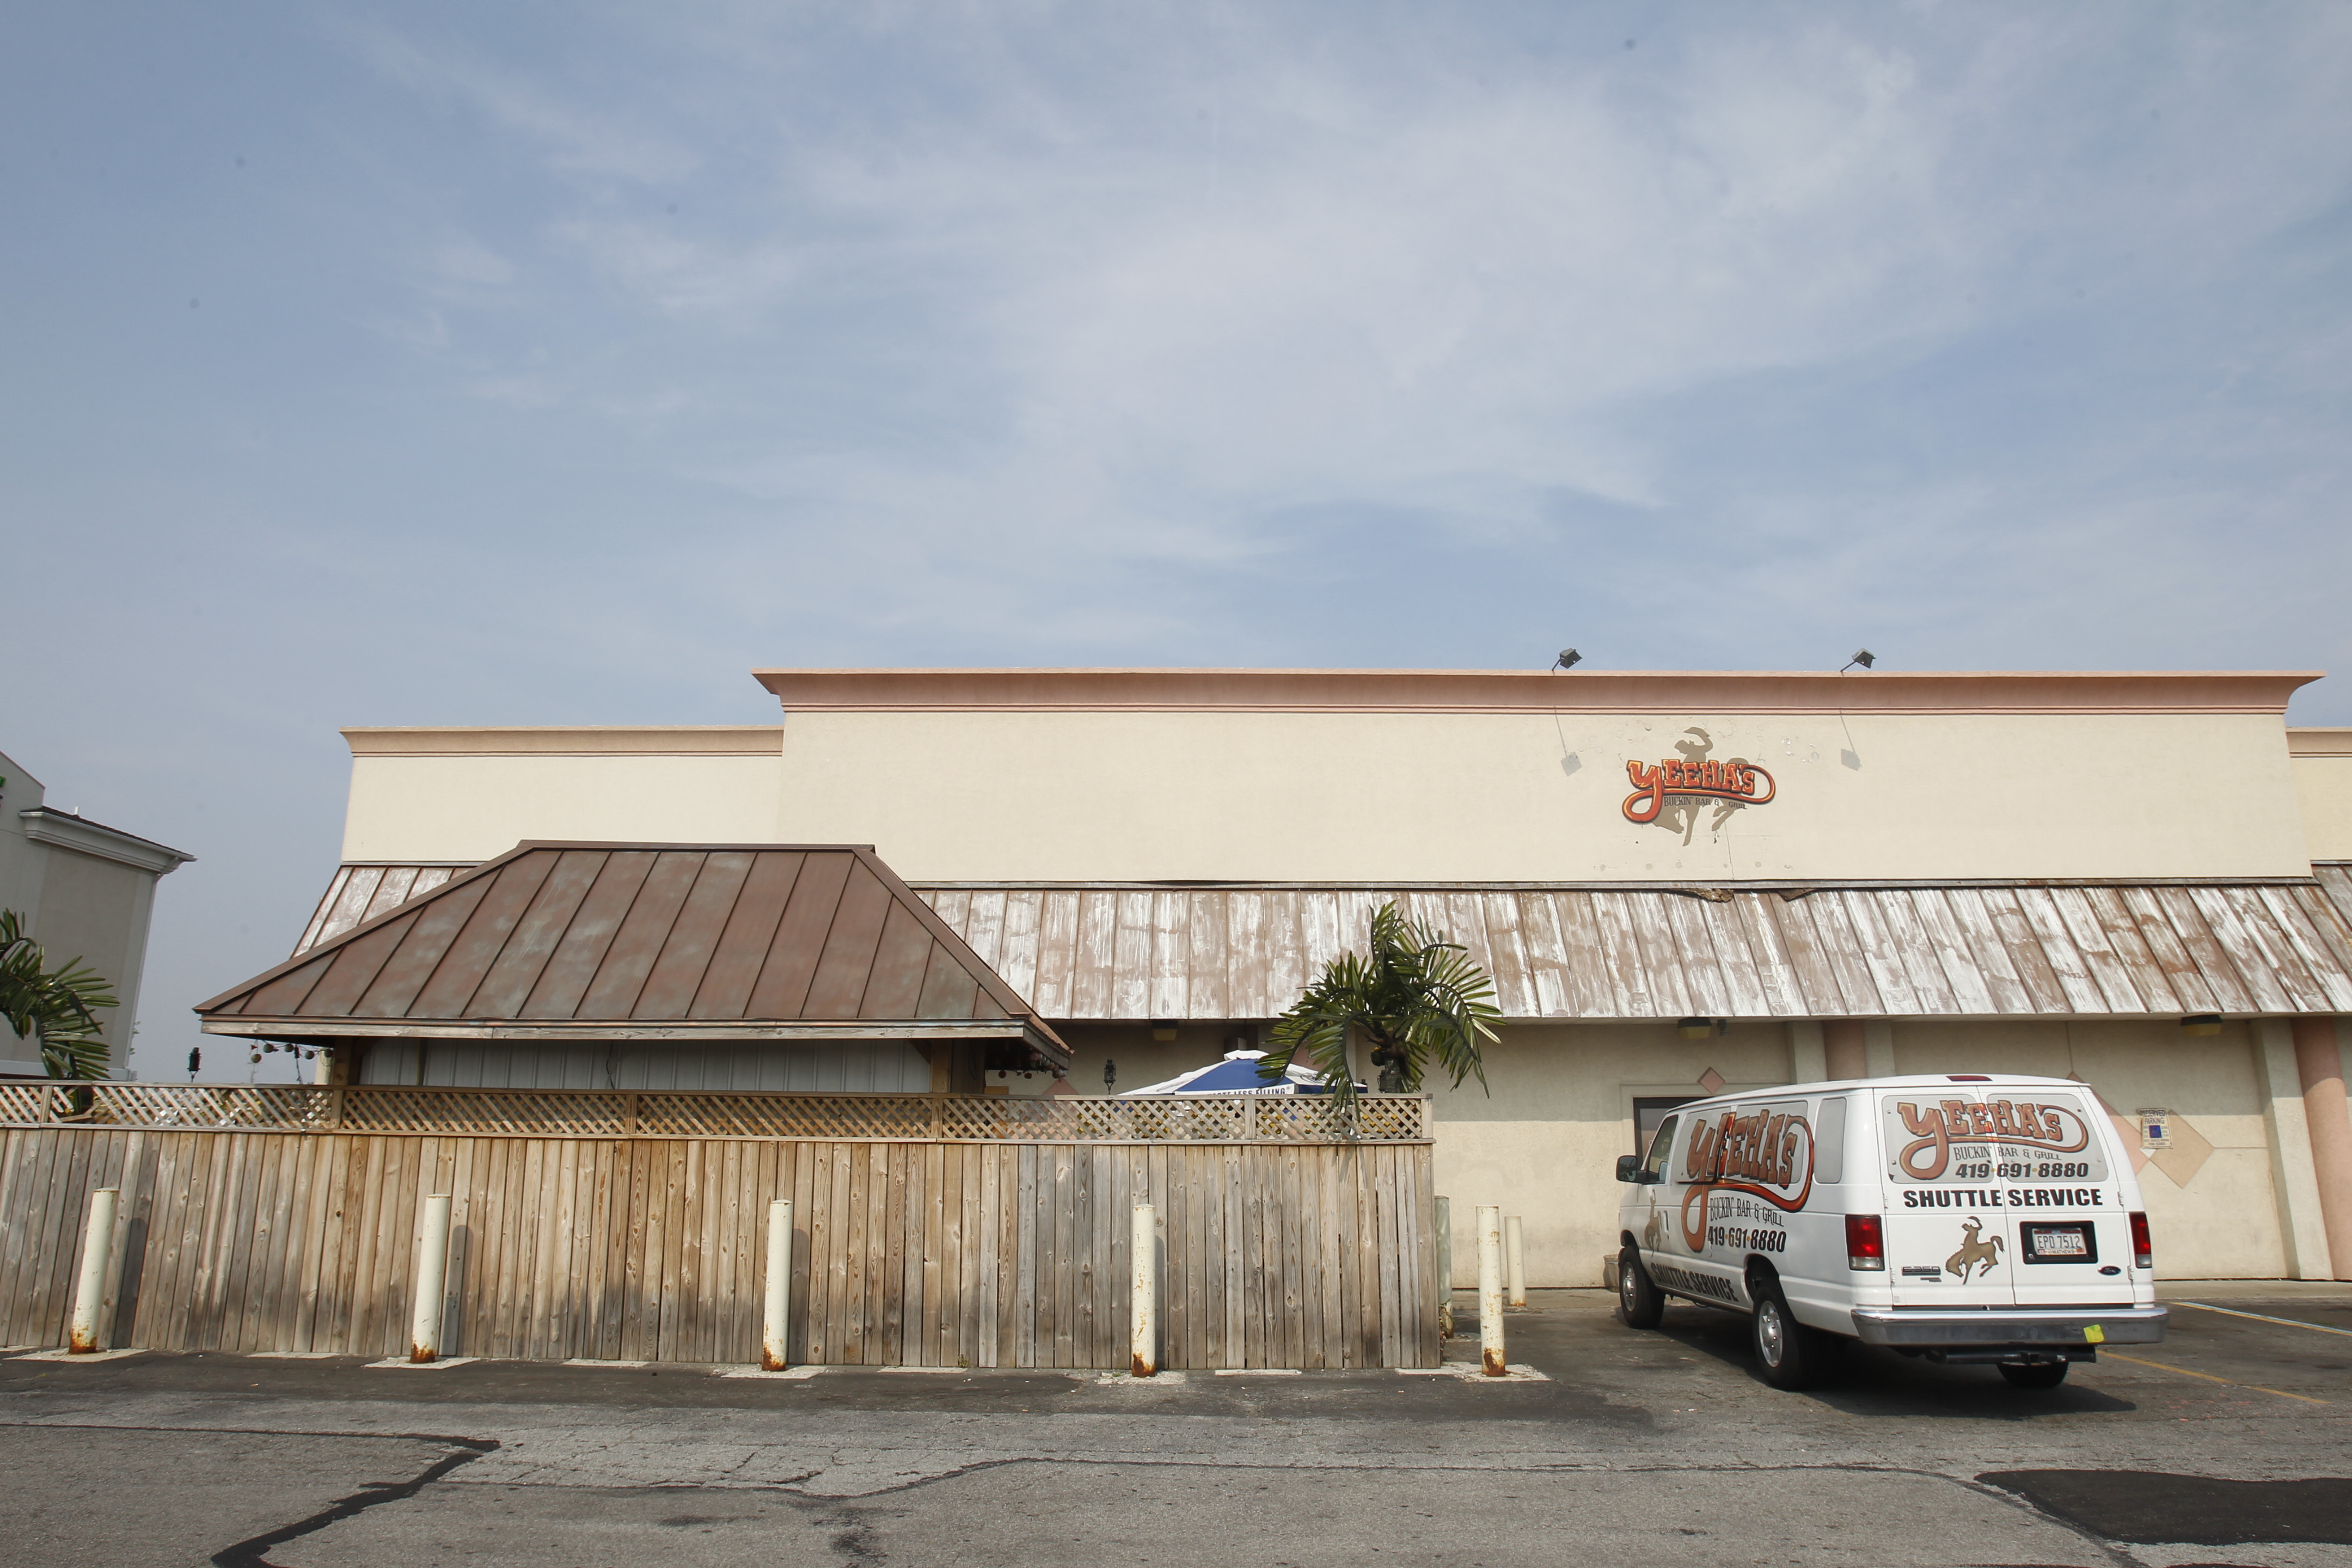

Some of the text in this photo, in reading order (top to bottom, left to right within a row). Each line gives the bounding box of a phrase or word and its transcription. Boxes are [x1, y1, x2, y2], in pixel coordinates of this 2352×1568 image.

[1622, 759, 1756, 823] YEEHA'S
[1664, 797, 1693, 806] BUCKIN'
[1695, 798, 1711, 806] BAR
[1714, 799, 1720, 807] &
[1897, 1100, 2064, 1180] YEEHA'S
[1953, 1146, 2062, 1161] BUCKIN' BAR & GRILL
[1903, 1189, 2103, 1208] SHUTTLE SERVICE
[1710, 1197, 1784, 1227] BUCKIN' BAR & GRILL
[2057, 1235, 2081, 1248] 7512
[1651, 1262, 1739, 1302] SHUTTLE SERVICE
